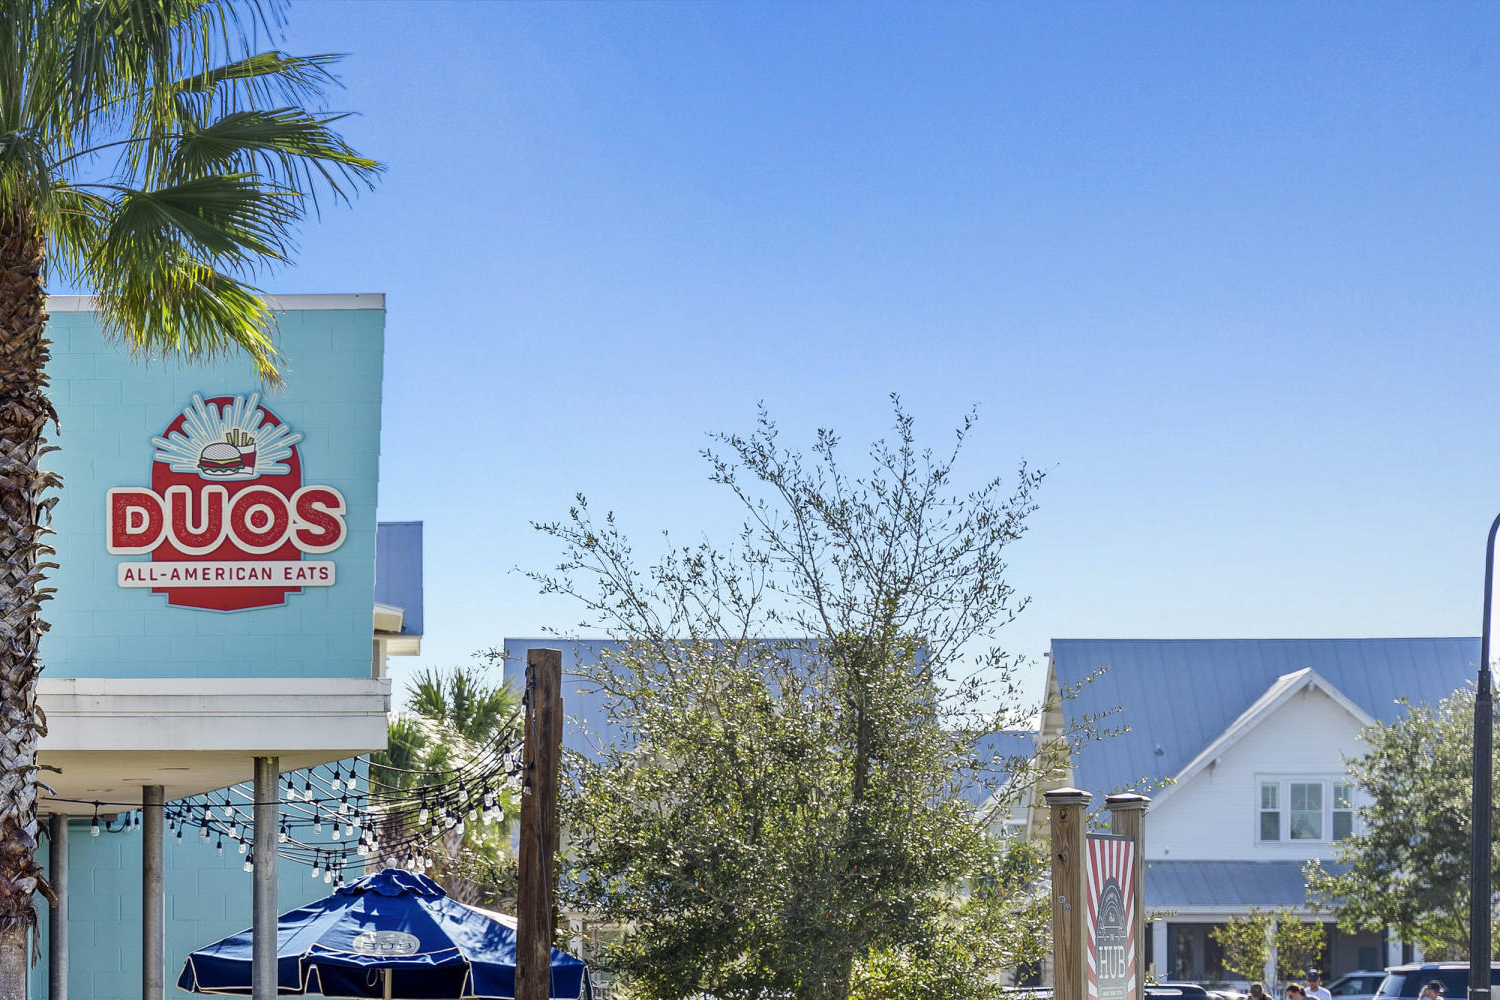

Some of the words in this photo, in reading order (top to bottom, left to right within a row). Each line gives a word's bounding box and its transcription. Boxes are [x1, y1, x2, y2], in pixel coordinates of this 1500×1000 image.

[109, 487, 344, 552] DUOS
[124, 567, 272, 581] ALL-AMERICAN
[284, 566, 329, 581] EATS
[1098, 945, 1126, 979] HUB
